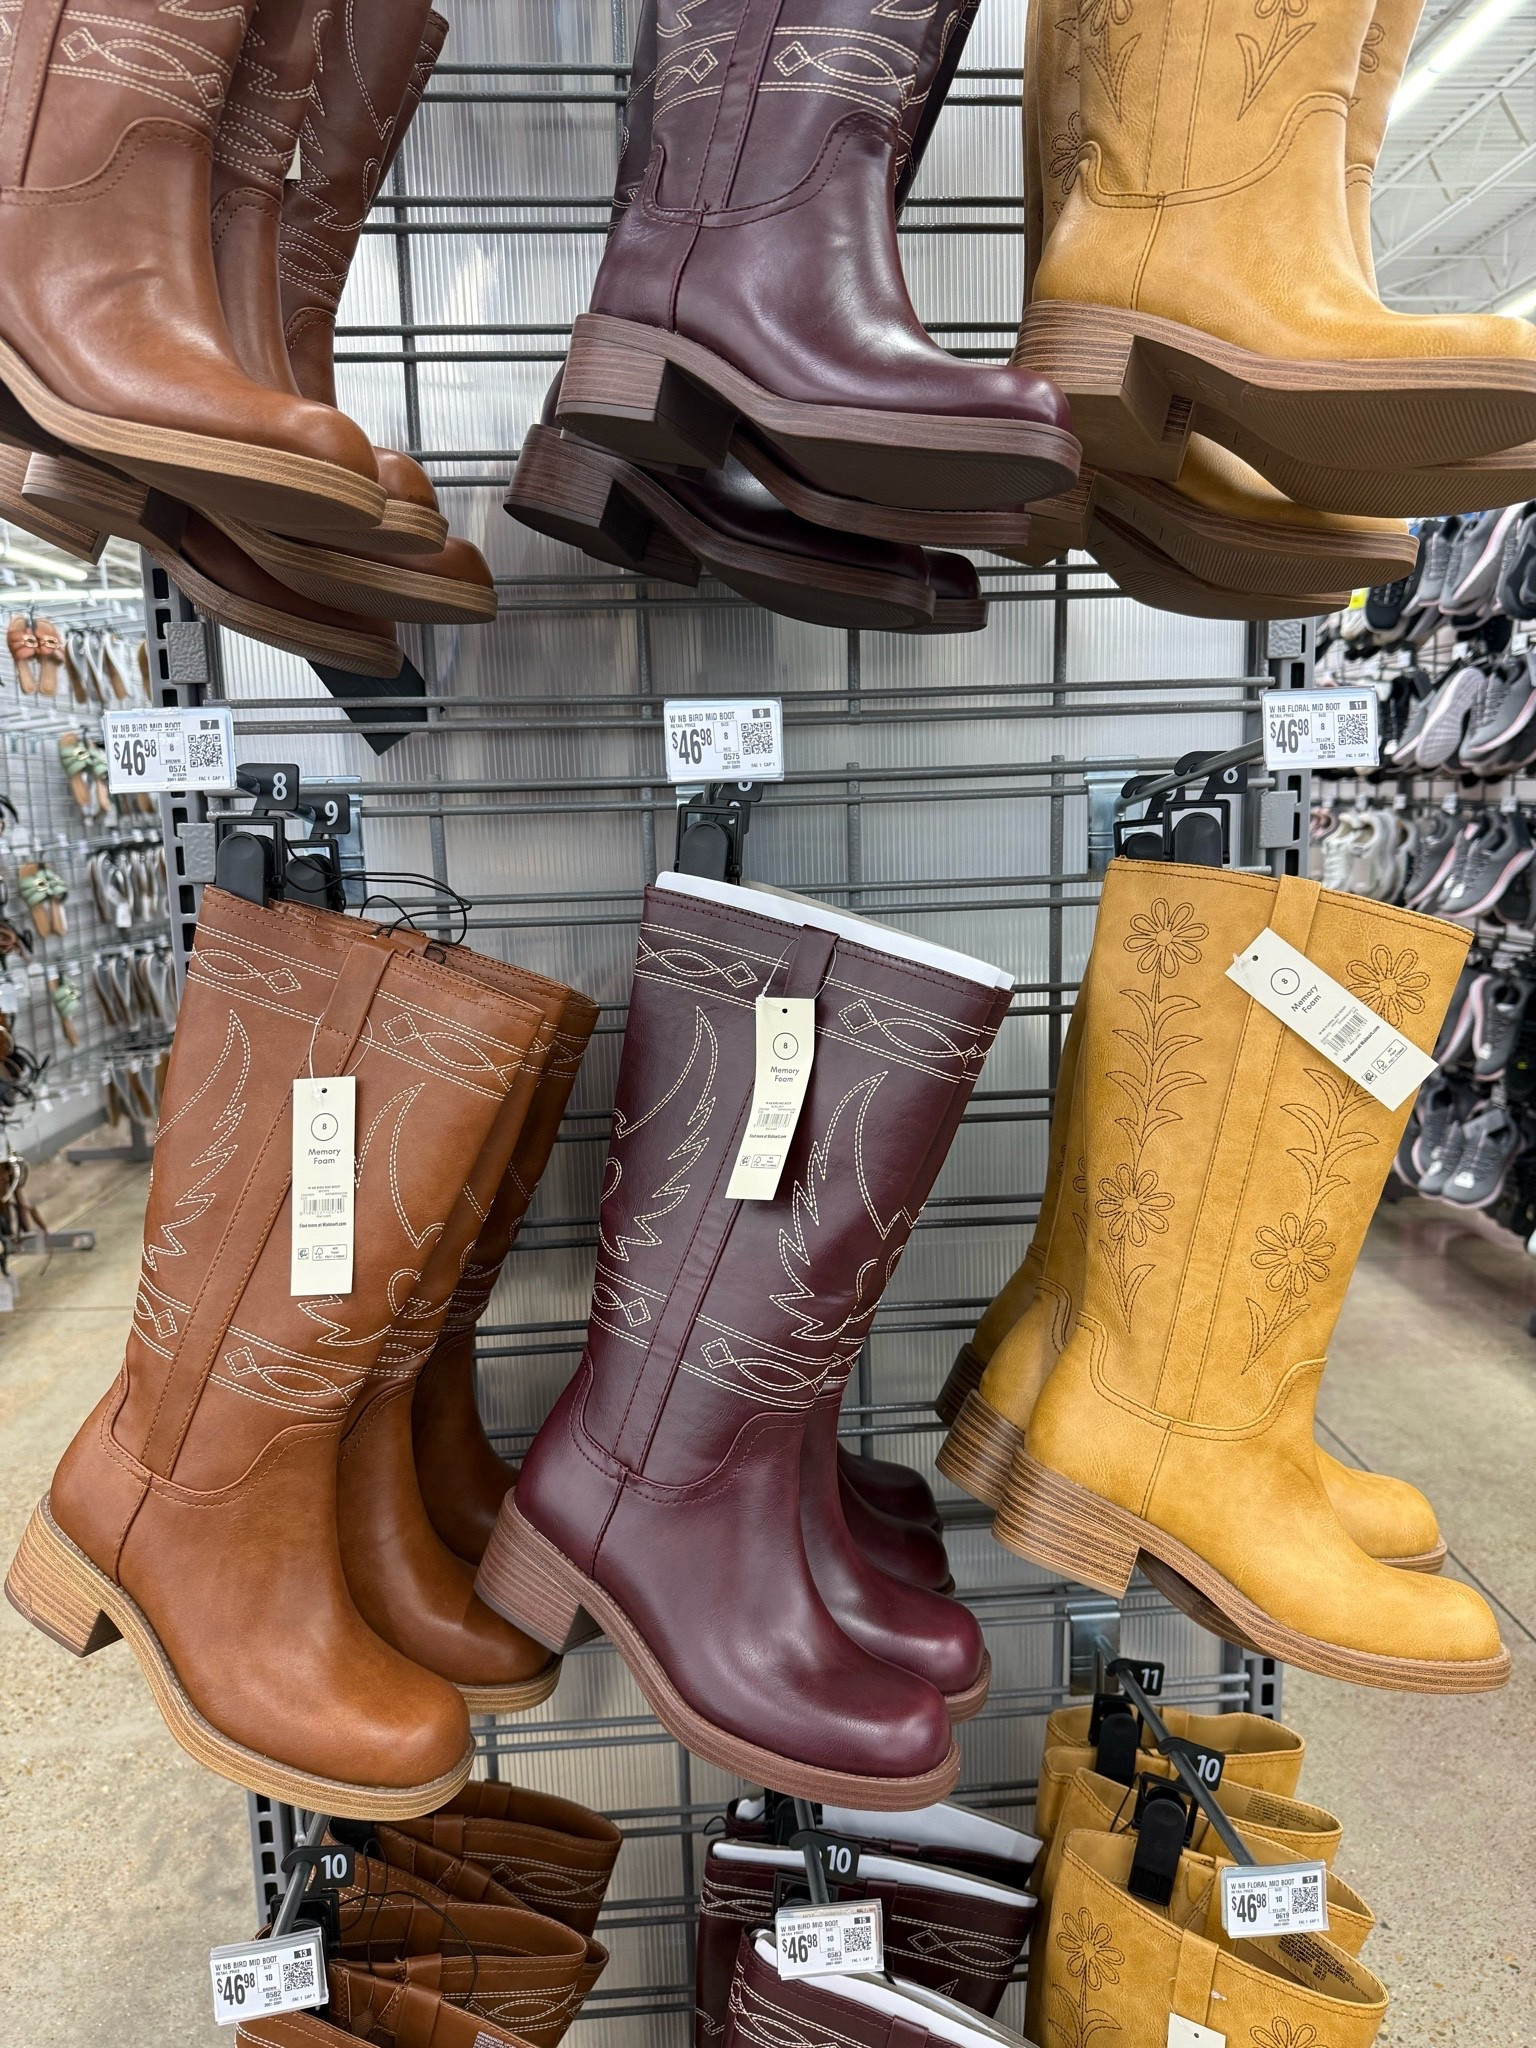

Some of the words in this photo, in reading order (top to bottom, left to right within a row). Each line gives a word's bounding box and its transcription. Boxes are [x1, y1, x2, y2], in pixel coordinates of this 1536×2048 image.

[720, 712, 734, 720] BOOT
[112, 724, 118, 732] W
[132, 724, 147, 732] BIRD
[150, 722, 162, 731] MID
[165, 722, 181, 730] BOOT
[207, 720, 212, 729] 7
[1320, 722, 1325, 730] 8
[724, 732, 728, 740] 8
[170, 744, 174, 752] 8
[1320, 742, 1335, 750] 0615
[272, 772, 287, 800] 8
[324, 801, 338, 826] 9
[1291, 985, 1318, 1012] Memory
[1302, 995, 1322, 1013] Foam
[1359, 1024, 1380, 1045] Walmart.com
[770, 1066, 799, 1076] Memory
[1141, 1668, 1160, 1690] 11
[1197, 1754, 1220, 1782] 10
[827, 1845, 852, 1873] 10
[320, 1854, 347, 1879] 10
[262, 1956, 277, 1964] BOOT
